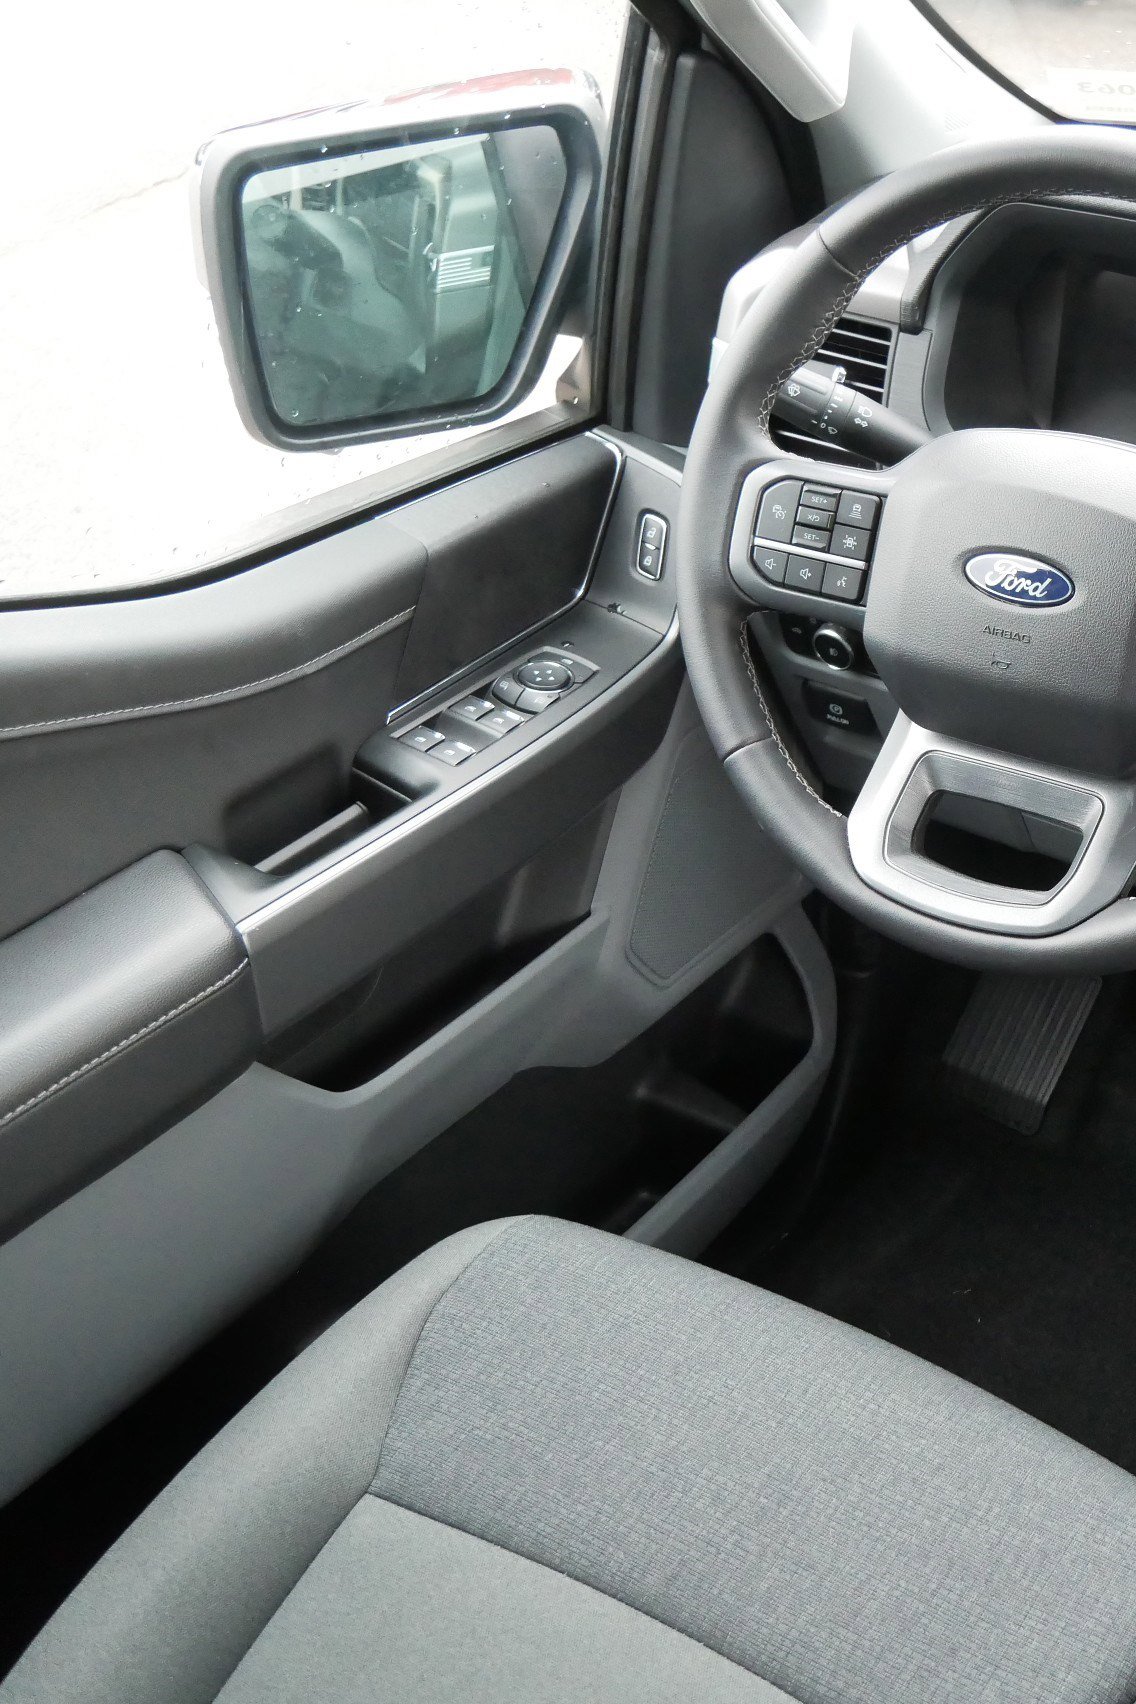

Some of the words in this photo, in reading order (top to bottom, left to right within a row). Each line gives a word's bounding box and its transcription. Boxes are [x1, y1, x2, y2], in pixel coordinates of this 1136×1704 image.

[811, 495, 828, 504] SET+
[984, 559, 1052, 598] Ford
[982, 624, 1031, 644] AIRBAG
